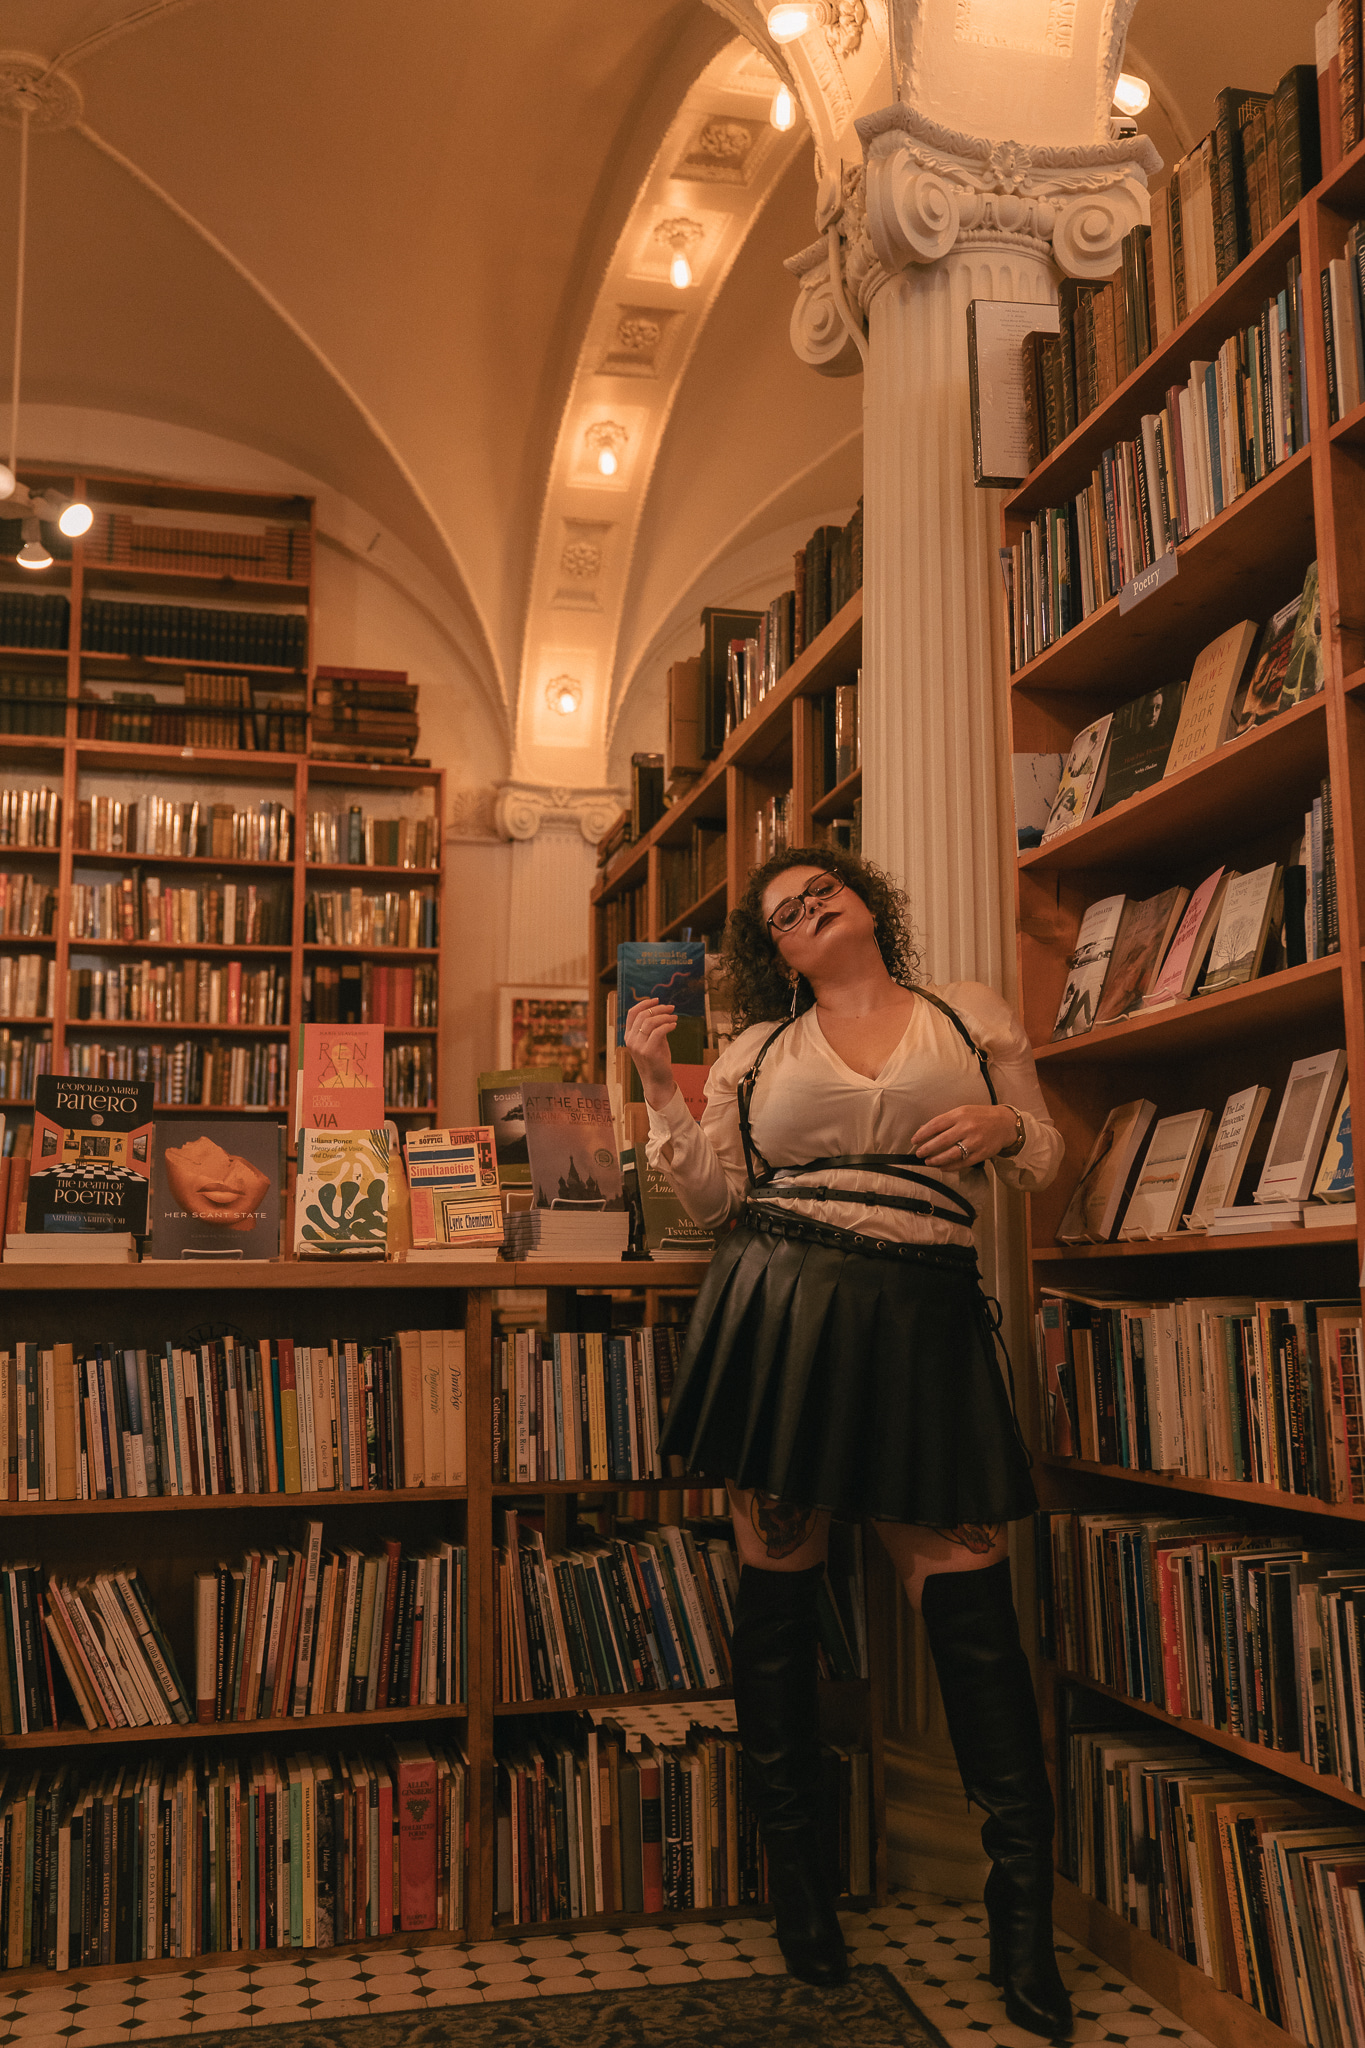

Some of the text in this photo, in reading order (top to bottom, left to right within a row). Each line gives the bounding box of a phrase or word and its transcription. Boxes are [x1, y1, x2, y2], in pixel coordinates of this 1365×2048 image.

[1321, 274, 1329, 308] KENNETH
[1135, 439, 1146, 509] GALWAY KINNELL
[1133, 568, 1160, 597] Poetry
[1194, 661, 1226, 690] HOWE
[1191, 684, 1217, 709] THIS
[1182, 703, 1214, 733] POOR
[1177, 723, 1210, 753] BOOK
[1182, 743, 1206, 762] POEM
[641, 950, 688, 960] swimming
[56, 1082, 110, 1093] LEOPOLDO
[55, 1092, 138, 1113] PANERO
[526, 1096, 610, 1110] AT THE EDGE
[1225, 1104, 1235, 1116] The
[313, 1113, 338, 1128] VIA
[527, 1112, 613, 1123] MARINA TSVETAEVA
[418, 1137, 443, 1145] SOFFICI
[1220, 1129, 1230, 1141] The
[410, 1163, 475, 1177] Simultaneities
[56, 1179, 125, 1190] THE DEATH OF
[54, 1189, 126, 1206] POETRY
[164, 1211, 187, 1219] HER
[191, 1211, 229, 1219] SCANT
[449, 1215, 464, 1230] Lyric
[449, 1365, 463, 1411] Paradiso
[1285, 1337, 1299, 1438] ARCHIBALD MacLEISH
[518, 1394, 527, 1425] Following
[1294, 1373, 1303, 1431] COLLECTED
[493, 1397, 501, 1436] Collected
[493, 1437, 501, 1464] Poems
[321, 1461, 329, 1478] Graph
[674, 1537, 693, 1592] LELAND HICKMAN
[250, 1576, 258, 1599] TOWARD
[399, 1570, 407, 1597] EVERYTHING
[301, 1537, 320, 1662] LAKE ANTIQUITY BRANDON DOWNING
[273, 1606, 282, 1619] Love
[272, 1628, 280, 1639] the
[404, 1626, 412, 1657] STEPHEN
[632, 1618, 648, 1669] Robert Hass
[270, 1641, 279, 1661] Streets
[382, 1632, 390, 1662] STEPHEN
[380, 1664, 388, 1683] DUNN
[402, 1659, 410, 1678] DUNN
[402, 1788, 435, 1796] GINSBERG
[407, 1781, 429, 1789] ALLEN
[401, 1823, 435, 1831] COLLECTED
[15, 1843, 23, 1865] Poems
[34, 1824, 44, 1894] ROSE SOLITUDE
[48, 1793, 58, 1916] Louise Erdrich BAPTISM OF DESIRE
[13, 1886, 22, 1907] George
[102, 1872, 110, 1906] SELECTED
[148, 1865, 156, 1923] ROMANTIC
[102, 1907, 110, 1933] POEMS
